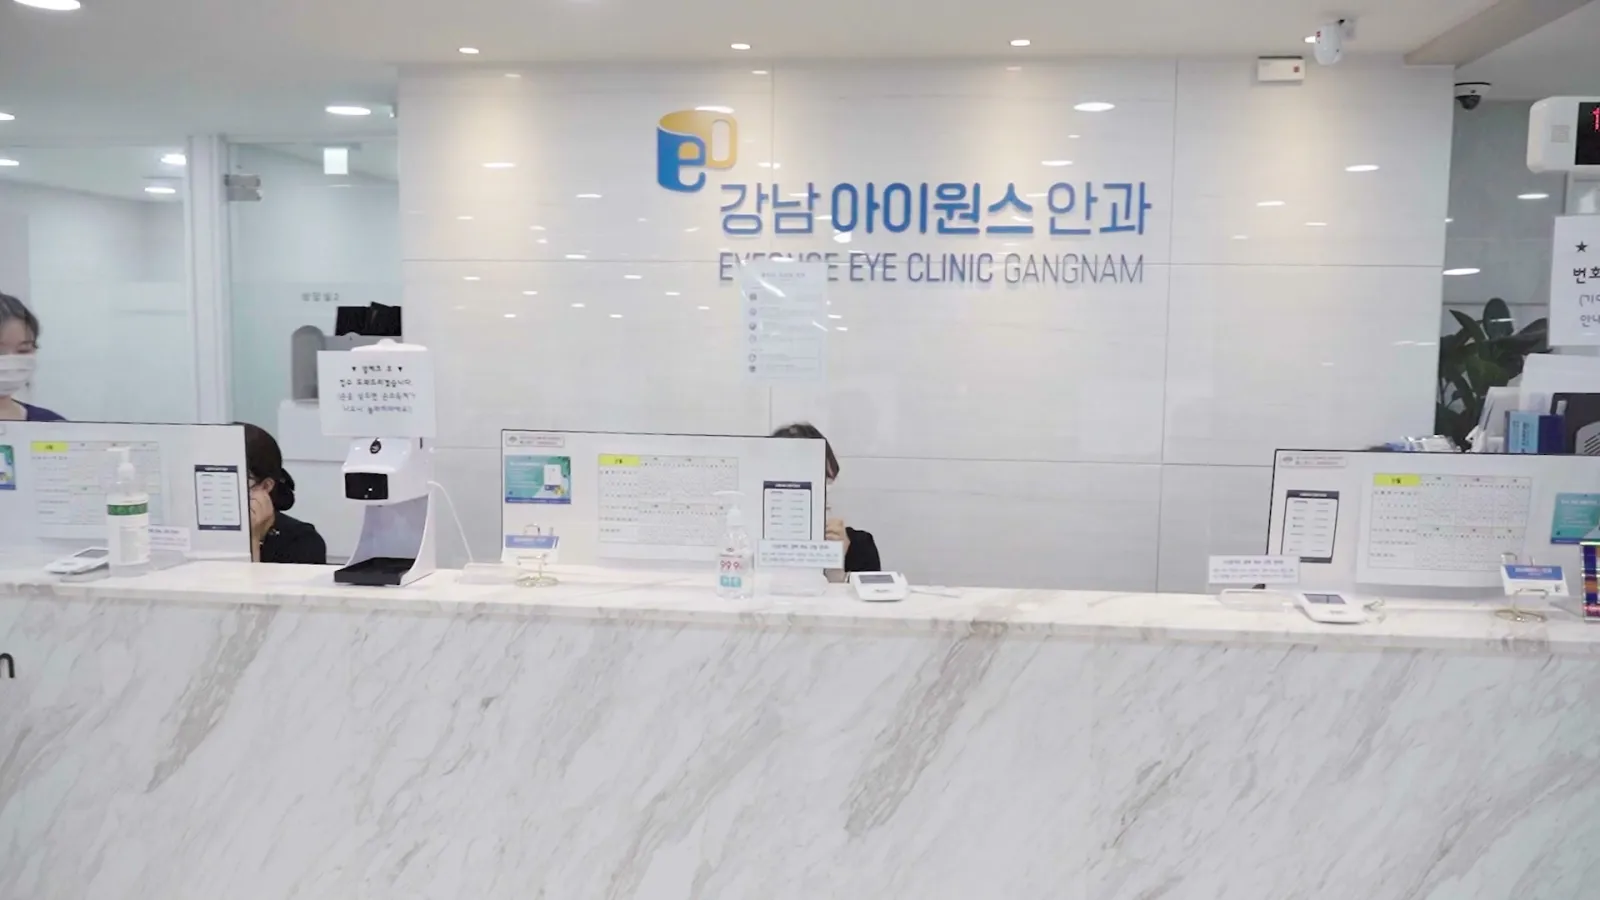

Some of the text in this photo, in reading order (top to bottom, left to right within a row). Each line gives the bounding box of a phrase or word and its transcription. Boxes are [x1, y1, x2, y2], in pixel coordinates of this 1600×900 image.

[720, 182, 1153, 235] 강남 아이원스 안과
[849, 252, 897, 282] EYE
[907, 252, 993, 282] CLINIC
[1004, 252, 1144, 284] GANGNAM
